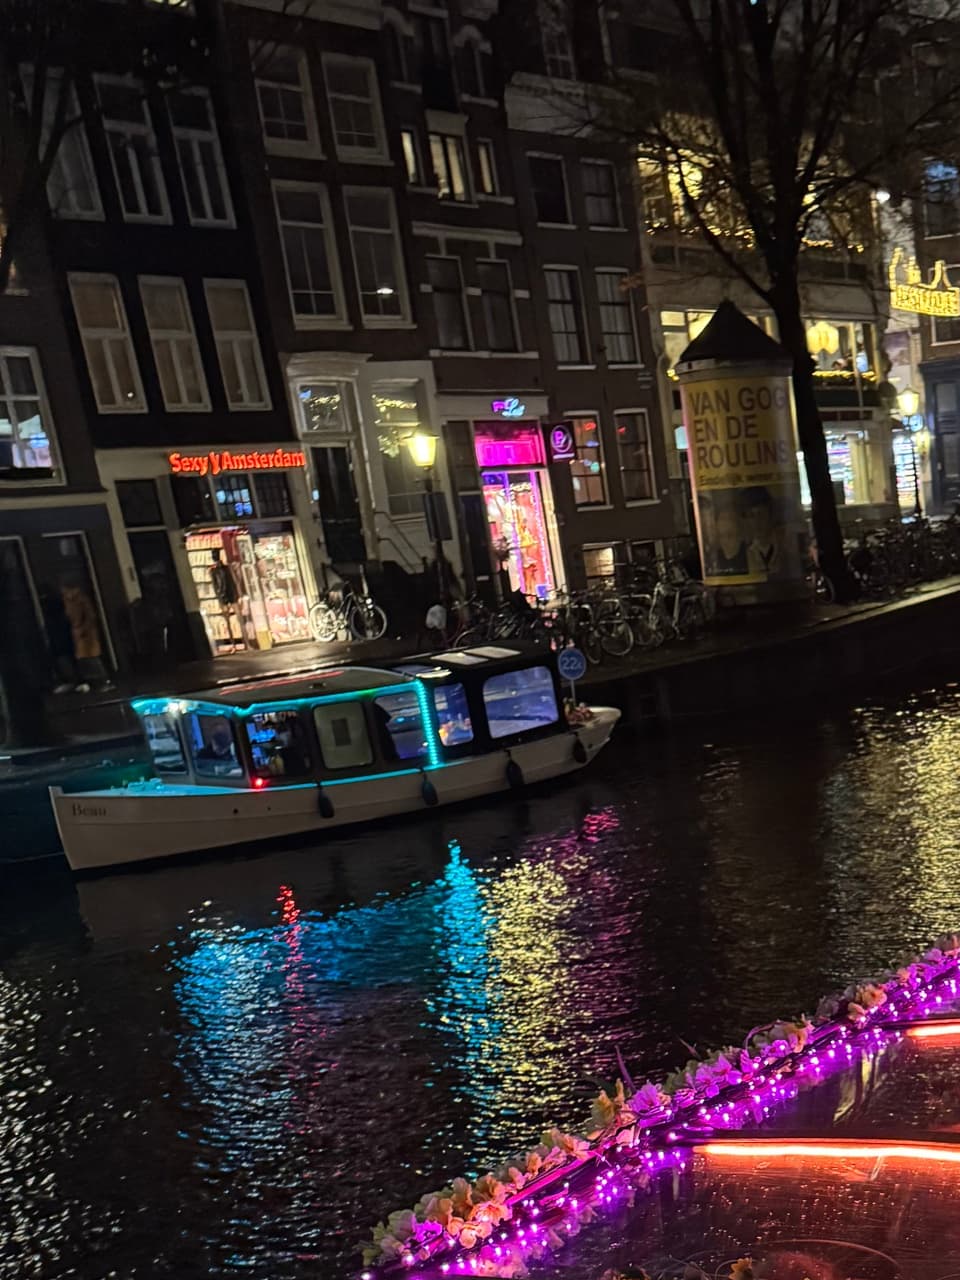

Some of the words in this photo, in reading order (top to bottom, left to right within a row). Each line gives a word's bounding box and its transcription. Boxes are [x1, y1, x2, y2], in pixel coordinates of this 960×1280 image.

[689, 388, 730, 416] VAN
[738, 386, 788, 412] GOG
[694, 418, 719, 443] EN
[726, 414, 758, 440] DE
[169, 452, 208, 476] Sexy
[221, 449, 306, 470] Amsterdam
[698, 440, 789, 470] ROULINS
